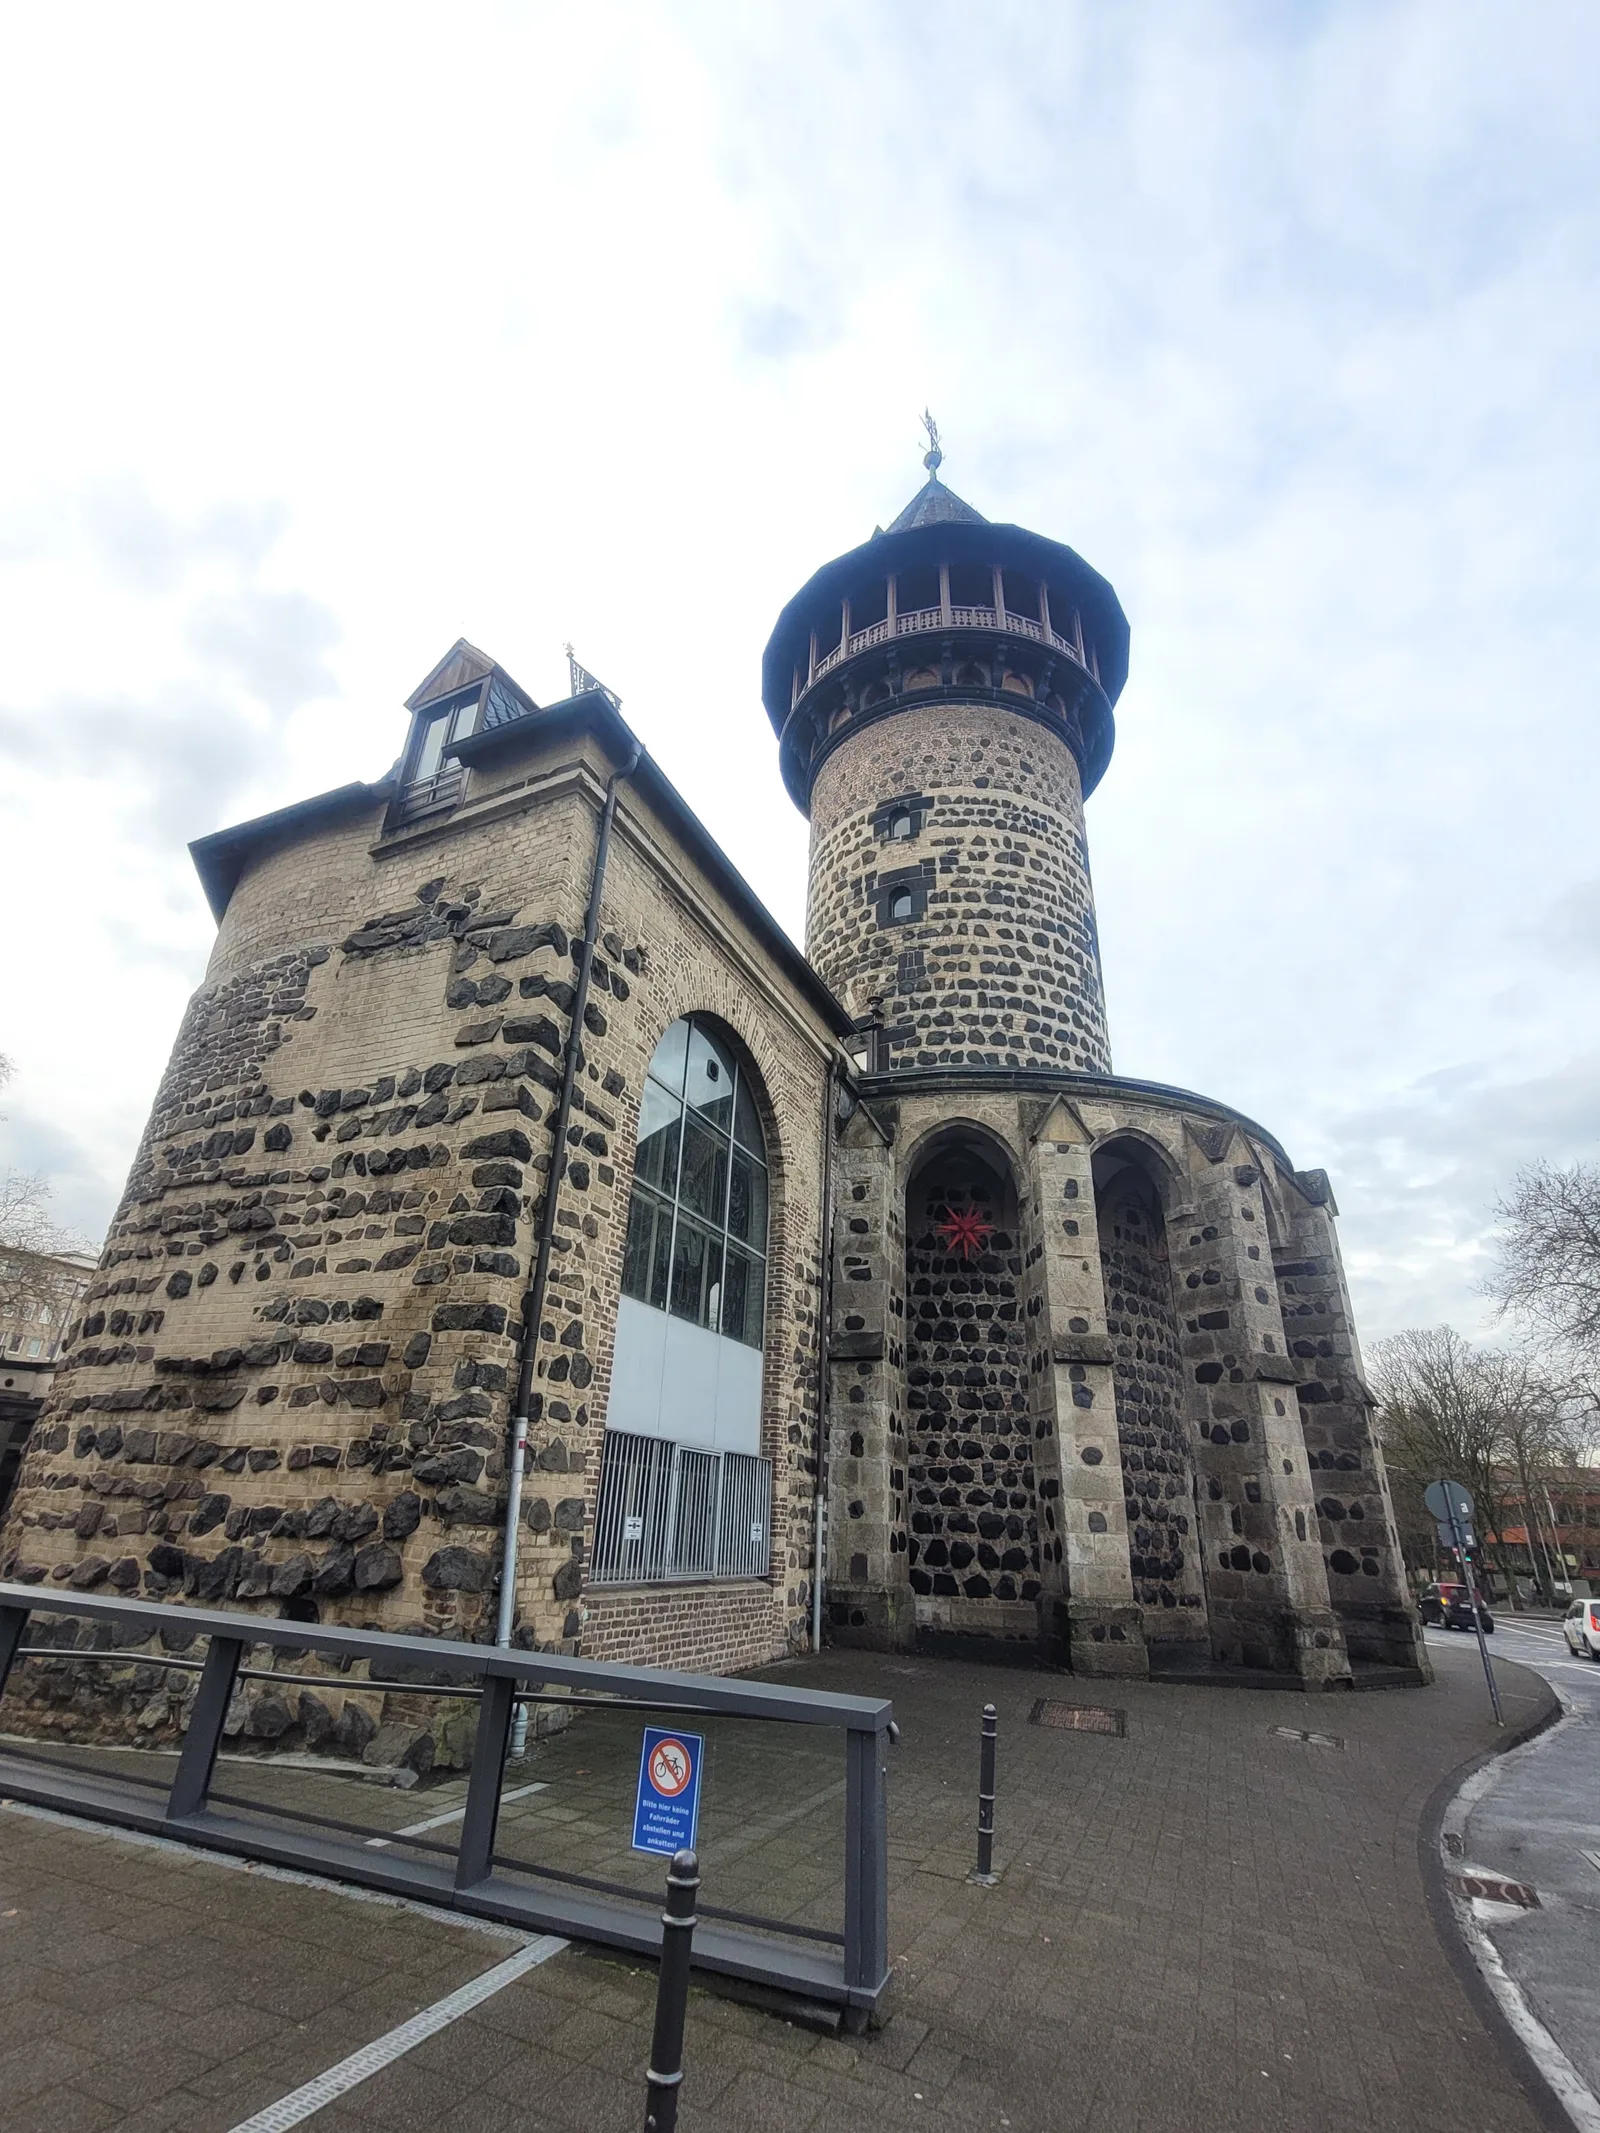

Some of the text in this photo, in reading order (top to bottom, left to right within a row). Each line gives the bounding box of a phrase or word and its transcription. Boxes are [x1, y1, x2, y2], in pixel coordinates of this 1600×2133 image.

[642, 1799, 689, 1815] Bitte hier keine
[649, 1813, 680, 1825] Fahrräder
[642, 1824, 685, 1839] abstellen und
[647, 1838, 677, 1849] anketten!
